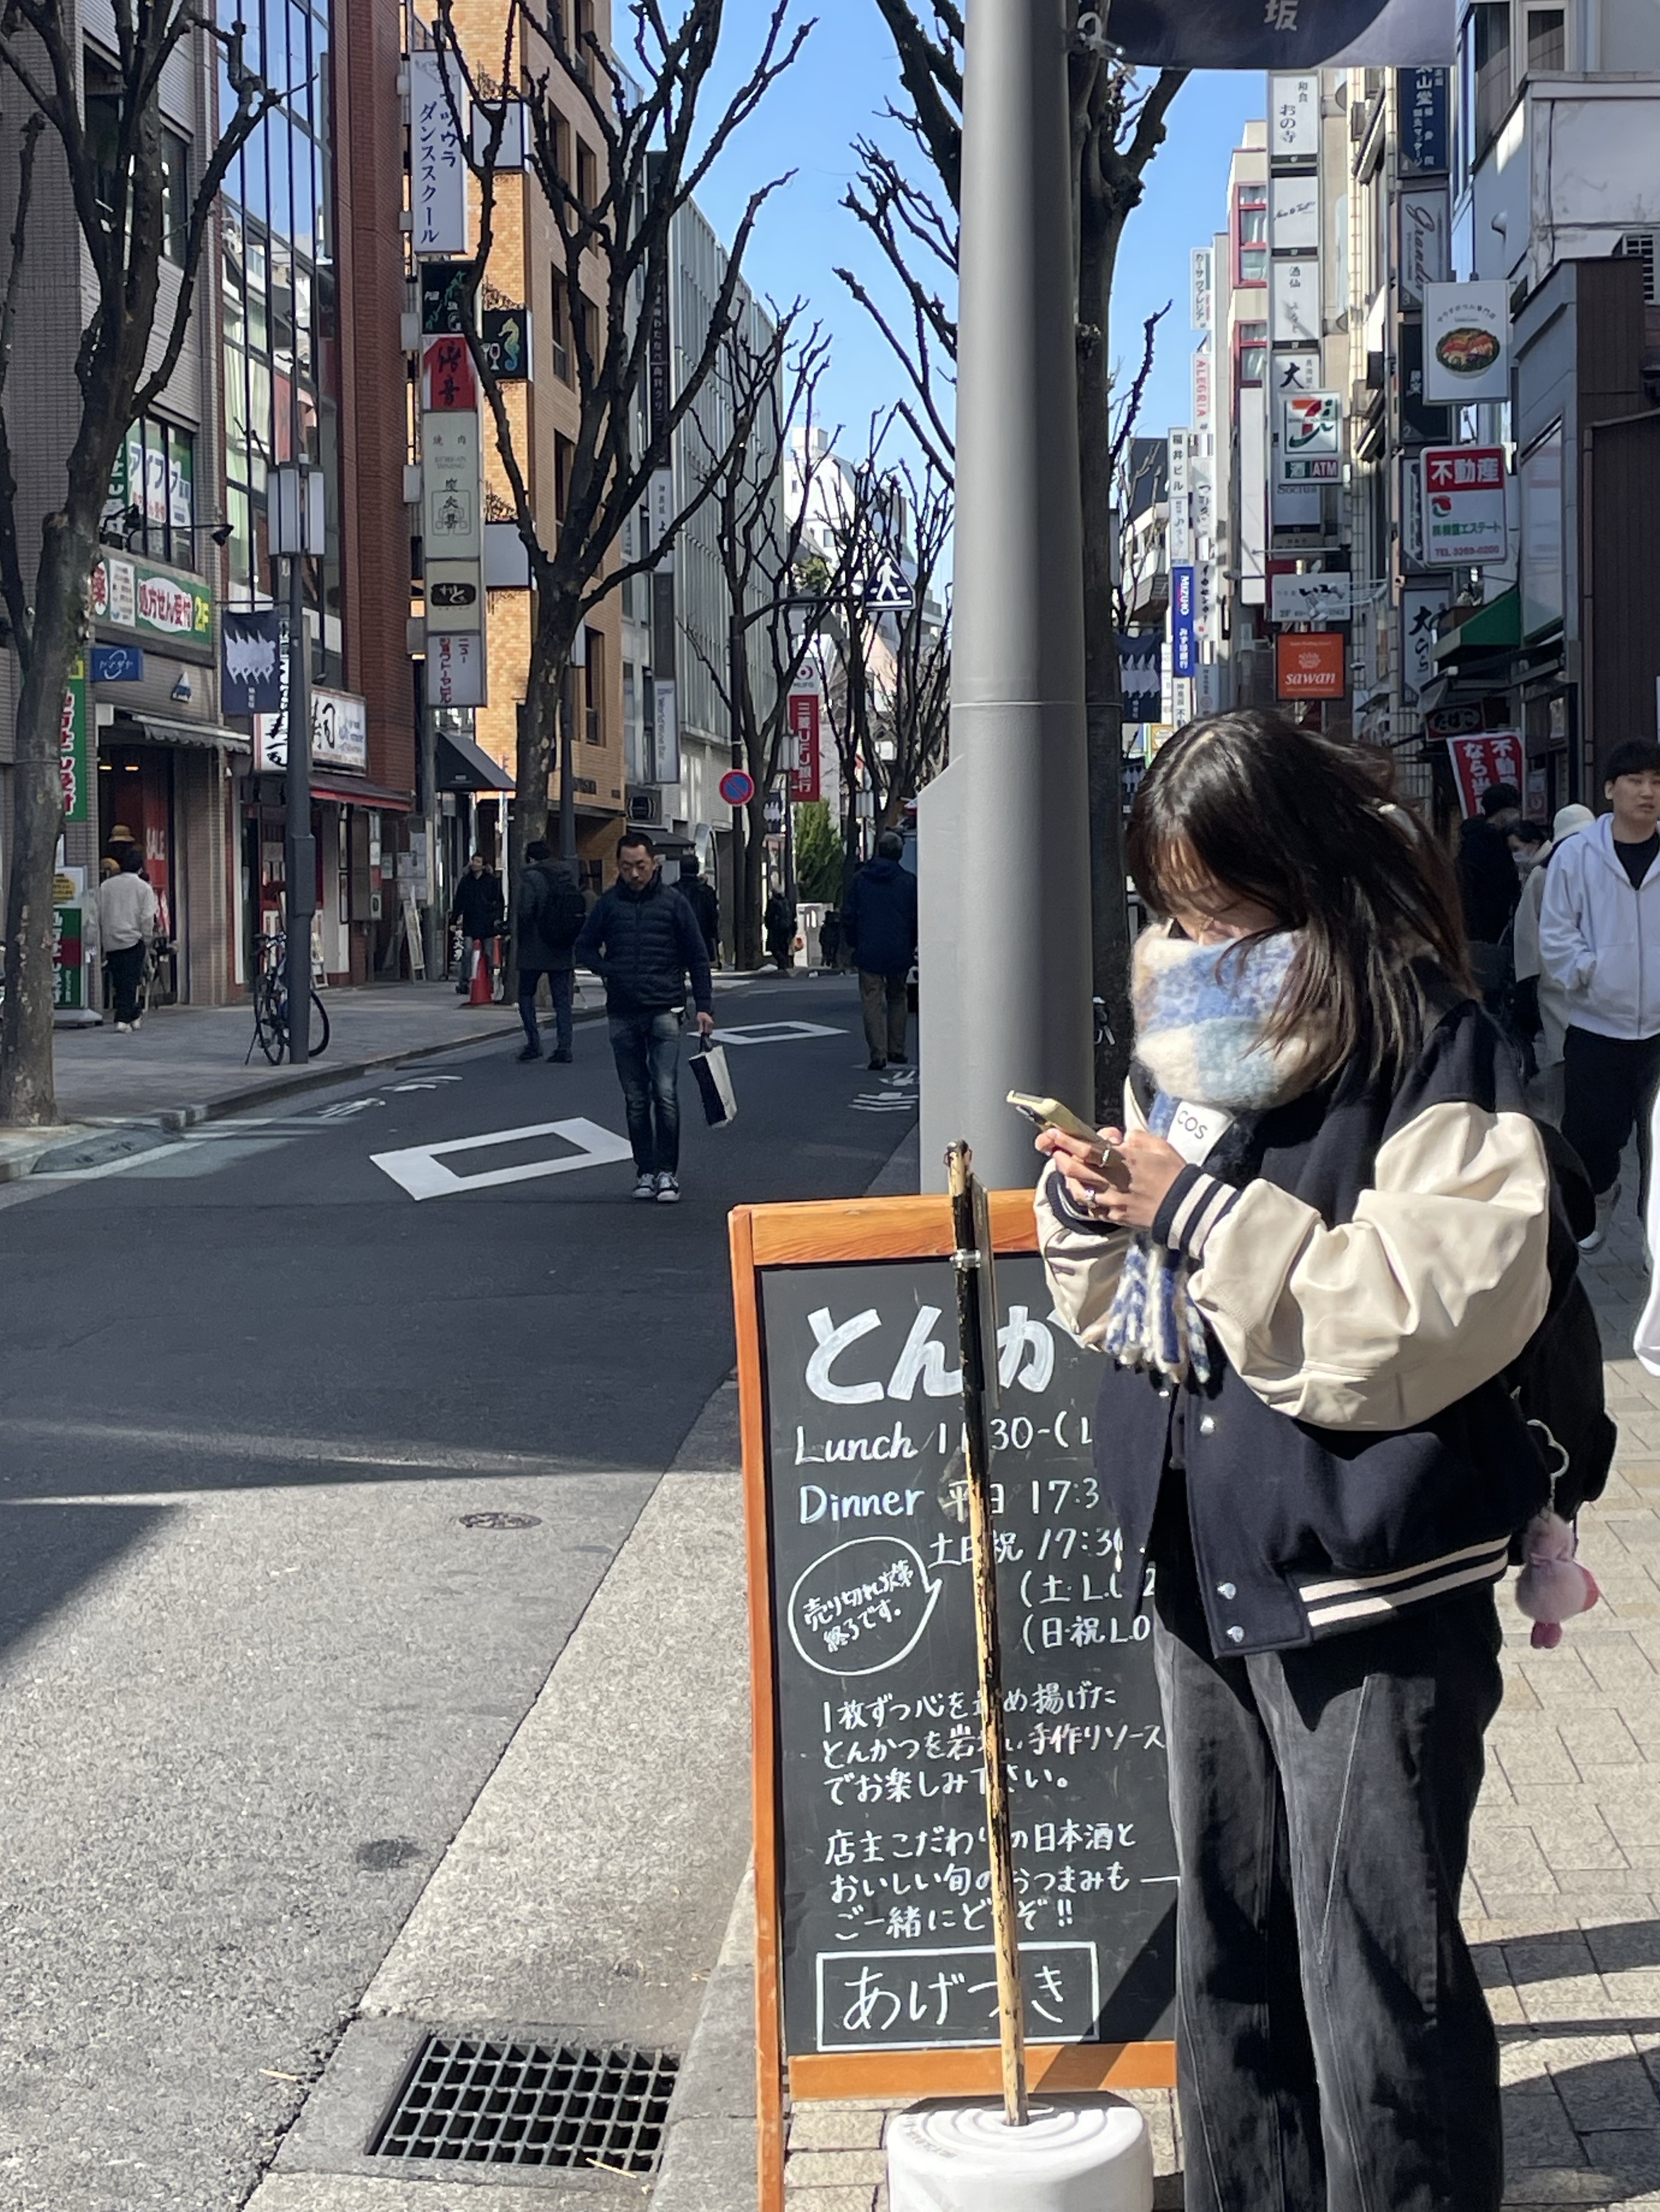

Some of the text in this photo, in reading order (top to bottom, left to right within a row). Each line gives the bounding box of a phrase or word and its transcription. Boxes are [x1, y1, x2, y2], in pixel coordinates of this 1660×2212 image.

[420, 100, 440, 244] ダンススクール
[1313, 462, 1337, 476] ATM
[1431, 458, 1500, 486] 不動産
[1180, 575, 1189, 616] MIZUHO
[1285, 673, 1335, 685] sawan
[1176, 1110, 1209, 1140] COS
[794, 1420, 919, 1465] Lunch
[800, 1479, 925, 1524] Dinner
